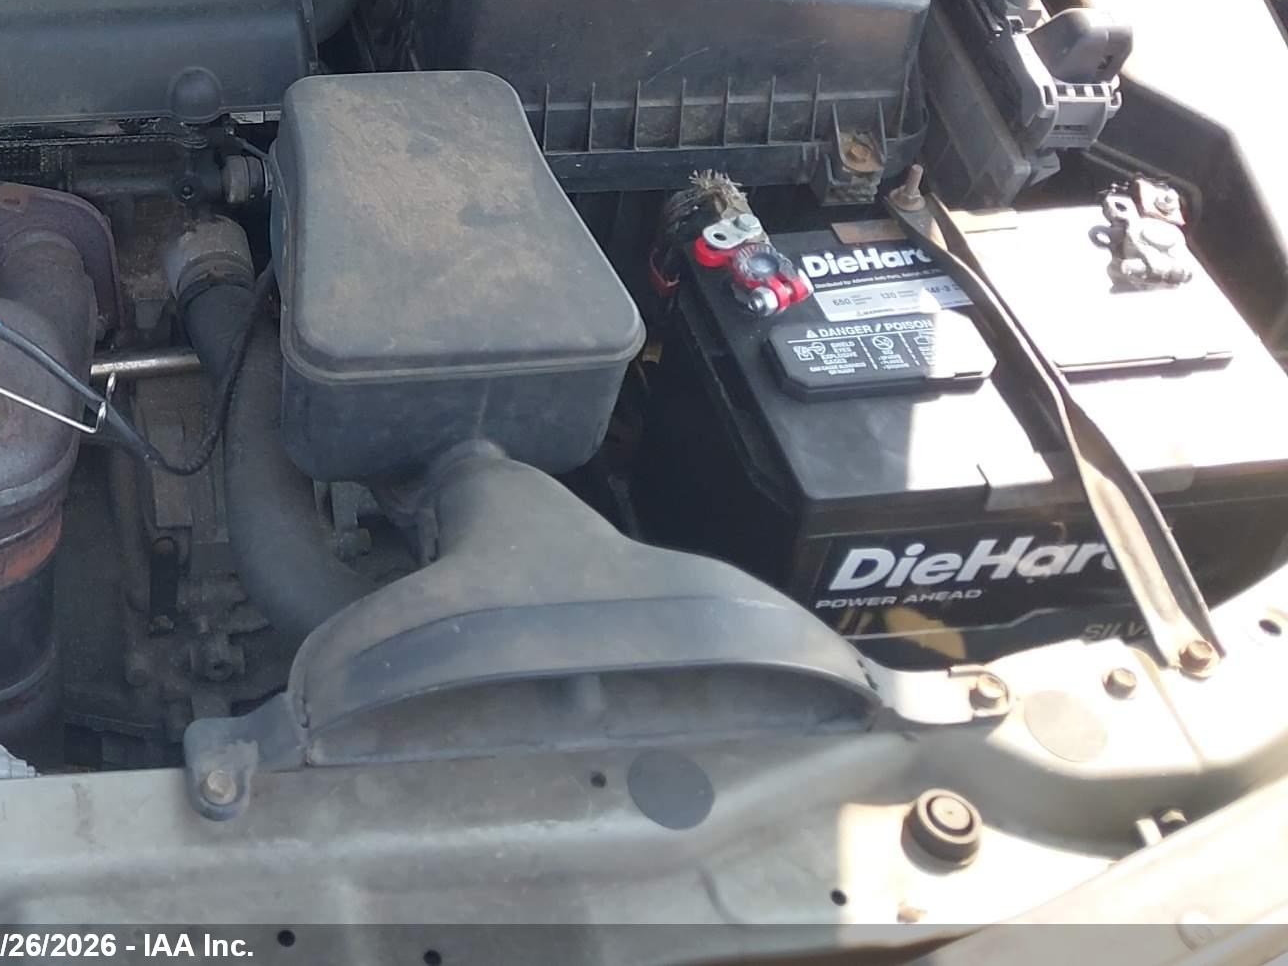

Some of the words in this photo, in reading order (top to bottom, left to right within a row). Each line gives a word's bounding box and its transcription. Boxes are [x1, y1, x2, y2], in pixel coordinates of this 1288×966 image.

[818, 325, 873, 338] DANGER
[885, 319, 933, 331] POISON
[829, 536, 1117, 591] DieHar
[815, 595, 898, 610] POWER
[902, 588, 982, 604] AHEAD
